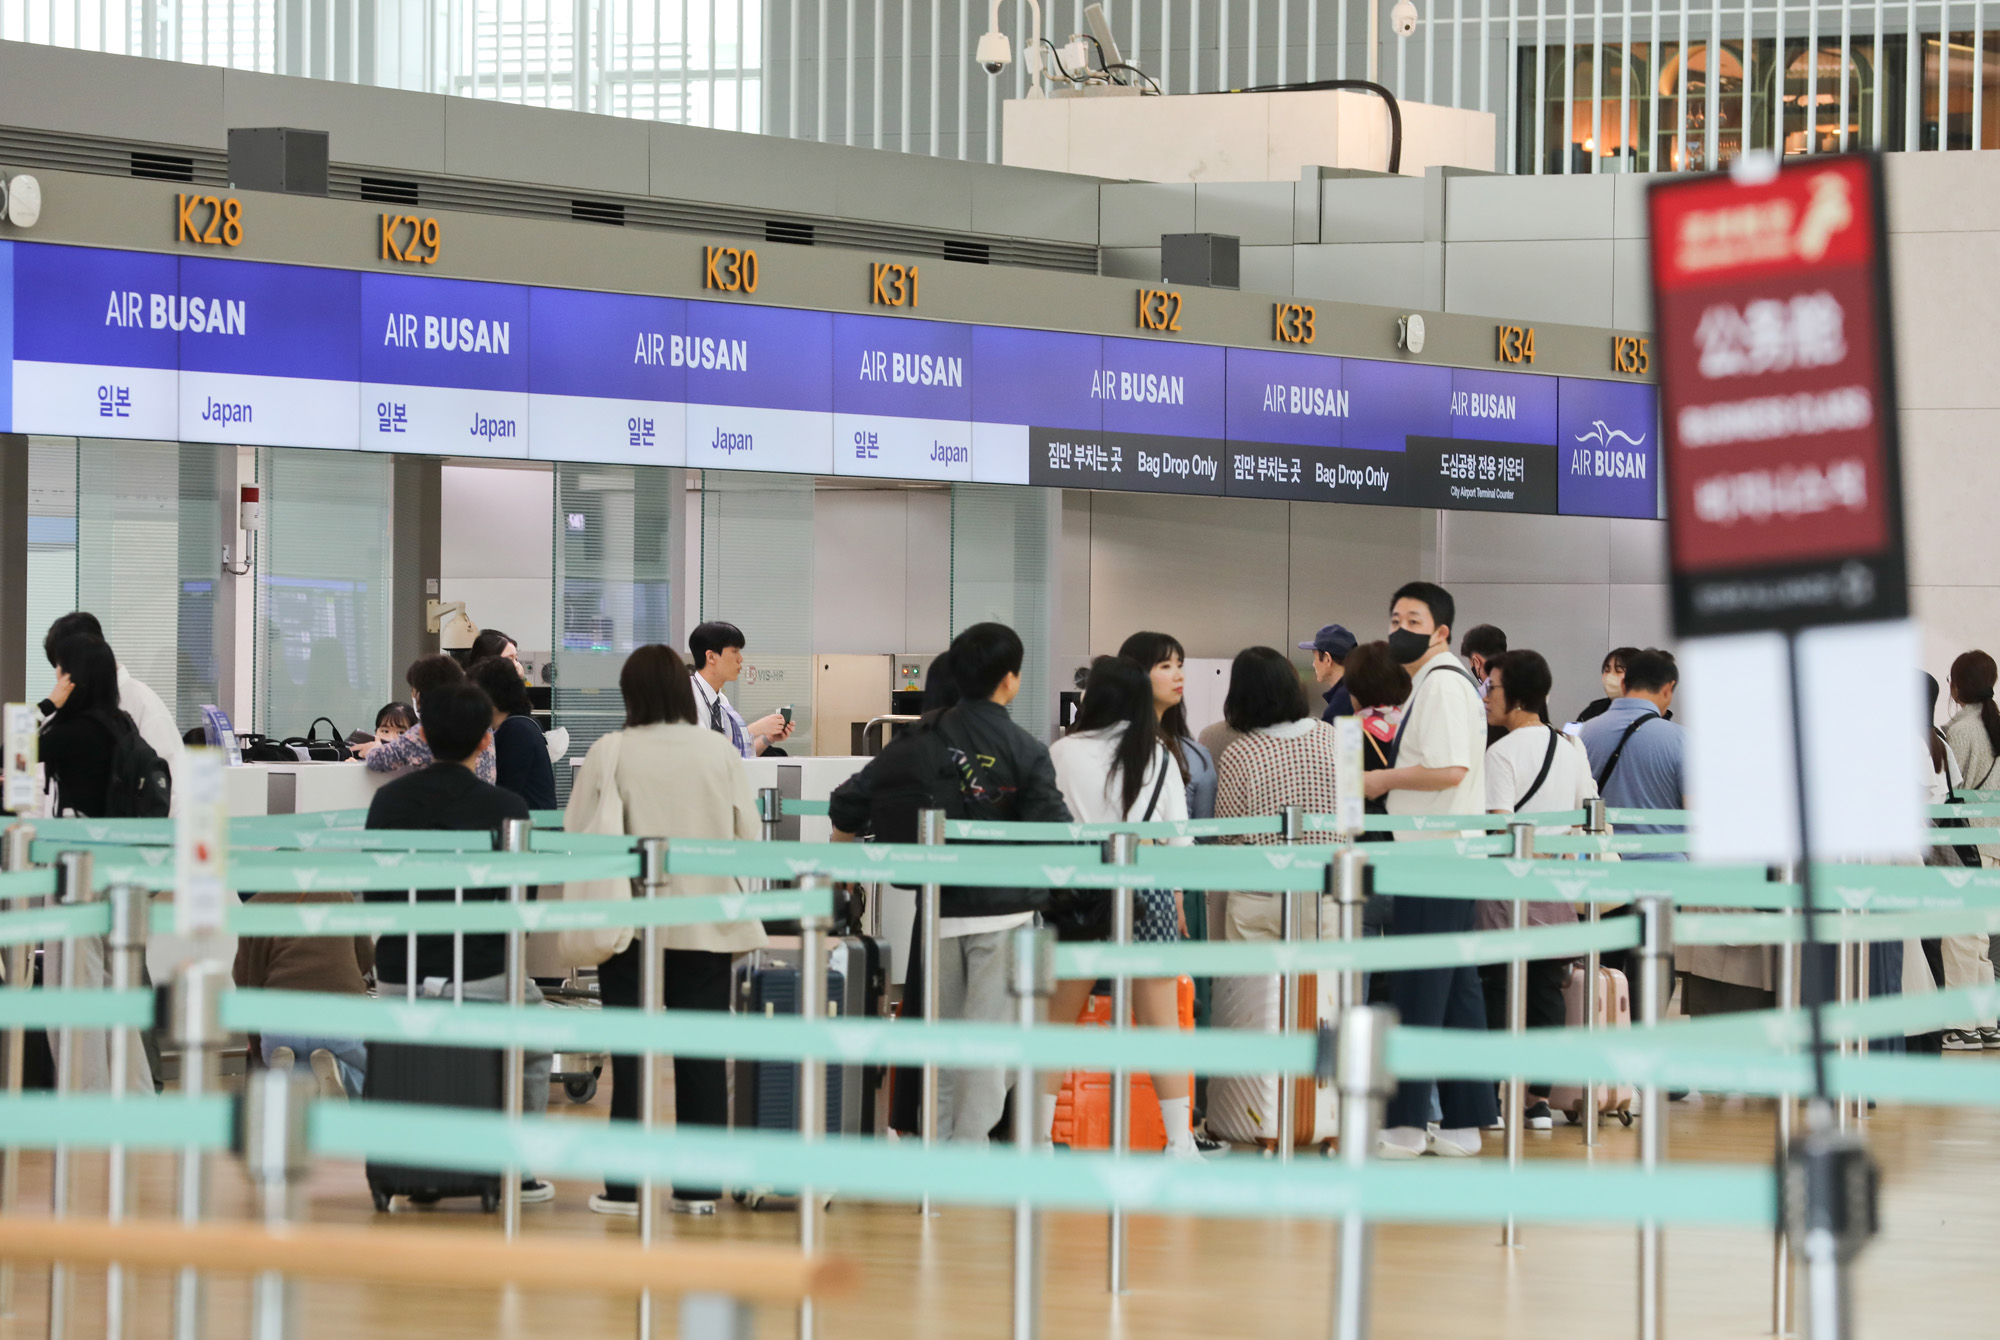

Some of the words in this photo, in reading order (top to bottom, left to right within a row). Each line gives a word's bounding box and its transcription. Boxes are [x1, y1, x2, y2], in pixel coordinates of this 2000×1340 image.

[176, 194, 244, 247] K28
[380, 213, 441, 264] K29
[704, 246, 759, 294] K30
[871, 262, 920, 308] K31
[105, 290, 143, 328] AIR
[149, 293, 246, 337] BUSAN
[1137, 288, 1182, 332] K32
[1273, 302, 1317, 344] K33
[384, 312, 418, 348] AIR
[424, 315, 510, 355] BUSAN
[634, 332, 665, 366] AIR
[670, 334, 748, 373] BUSAN
[1496, 324, 1537, 364] K34
[859, 350, 887, 383] AIR
[892, 353, 963, 388] BUSAN
[1613, 335, 1650, 374] K35
[97, 385, 131, 419] 일본
[201, 396, 253, 428] Japan
[1090, 369, 1117, 401] AIR
[1120, 371, 1184, 406] BUSAN
[1263, 383, 1287, 414] AIR
[1290, 385, 1350, 418] BUSAN
[1450, 389, 1468, 417] AIR
[1471, 391, 1516, 421] BUSAN
[377, 402, 408, 434] 일본
[470, 412, 517, 443] Japan
[628, 416, 656, 448] 일본
[711, 426, 753, 454] Japan
[853, 430, 880, 460] 일본
[930, 439, 969, 466] Japan
[1048, 442, 1072, 470] 짐만
[1074, 444, 1108, 472] 부치는
[1111, 446, 1123, 473] 곳
[1137, 450, 1160, 479] Bag
[1163, 453, 1190, 480] Drop
[1193, 454, 1218, 481] Only
[1571, 447, 1592, 477] AIR
[1594, 449, 1646, 480] BUSAN
[1233, 453, 1255, 480] 짐만
[1257, 455, 1288, 482] 부치는
[1290, 458, 1301, 484] 곳
[1315, 463, 1336, 489] Bag
[1338, 464, 1363, 490] Drop
[1365, 465, 1390, 492] Only
[1440, 453, 1476, 480] 도심공항
[1478, 454, 1497, 481] 전용
[1498, 456, 1524, 483] 카운터
[1450, 486, 1460, 499] City
[1460, 487, 1477, 500] Airport
[1476, 487, 1496, 499] Terminal
[1496, 489, 1514, 500] Counter
